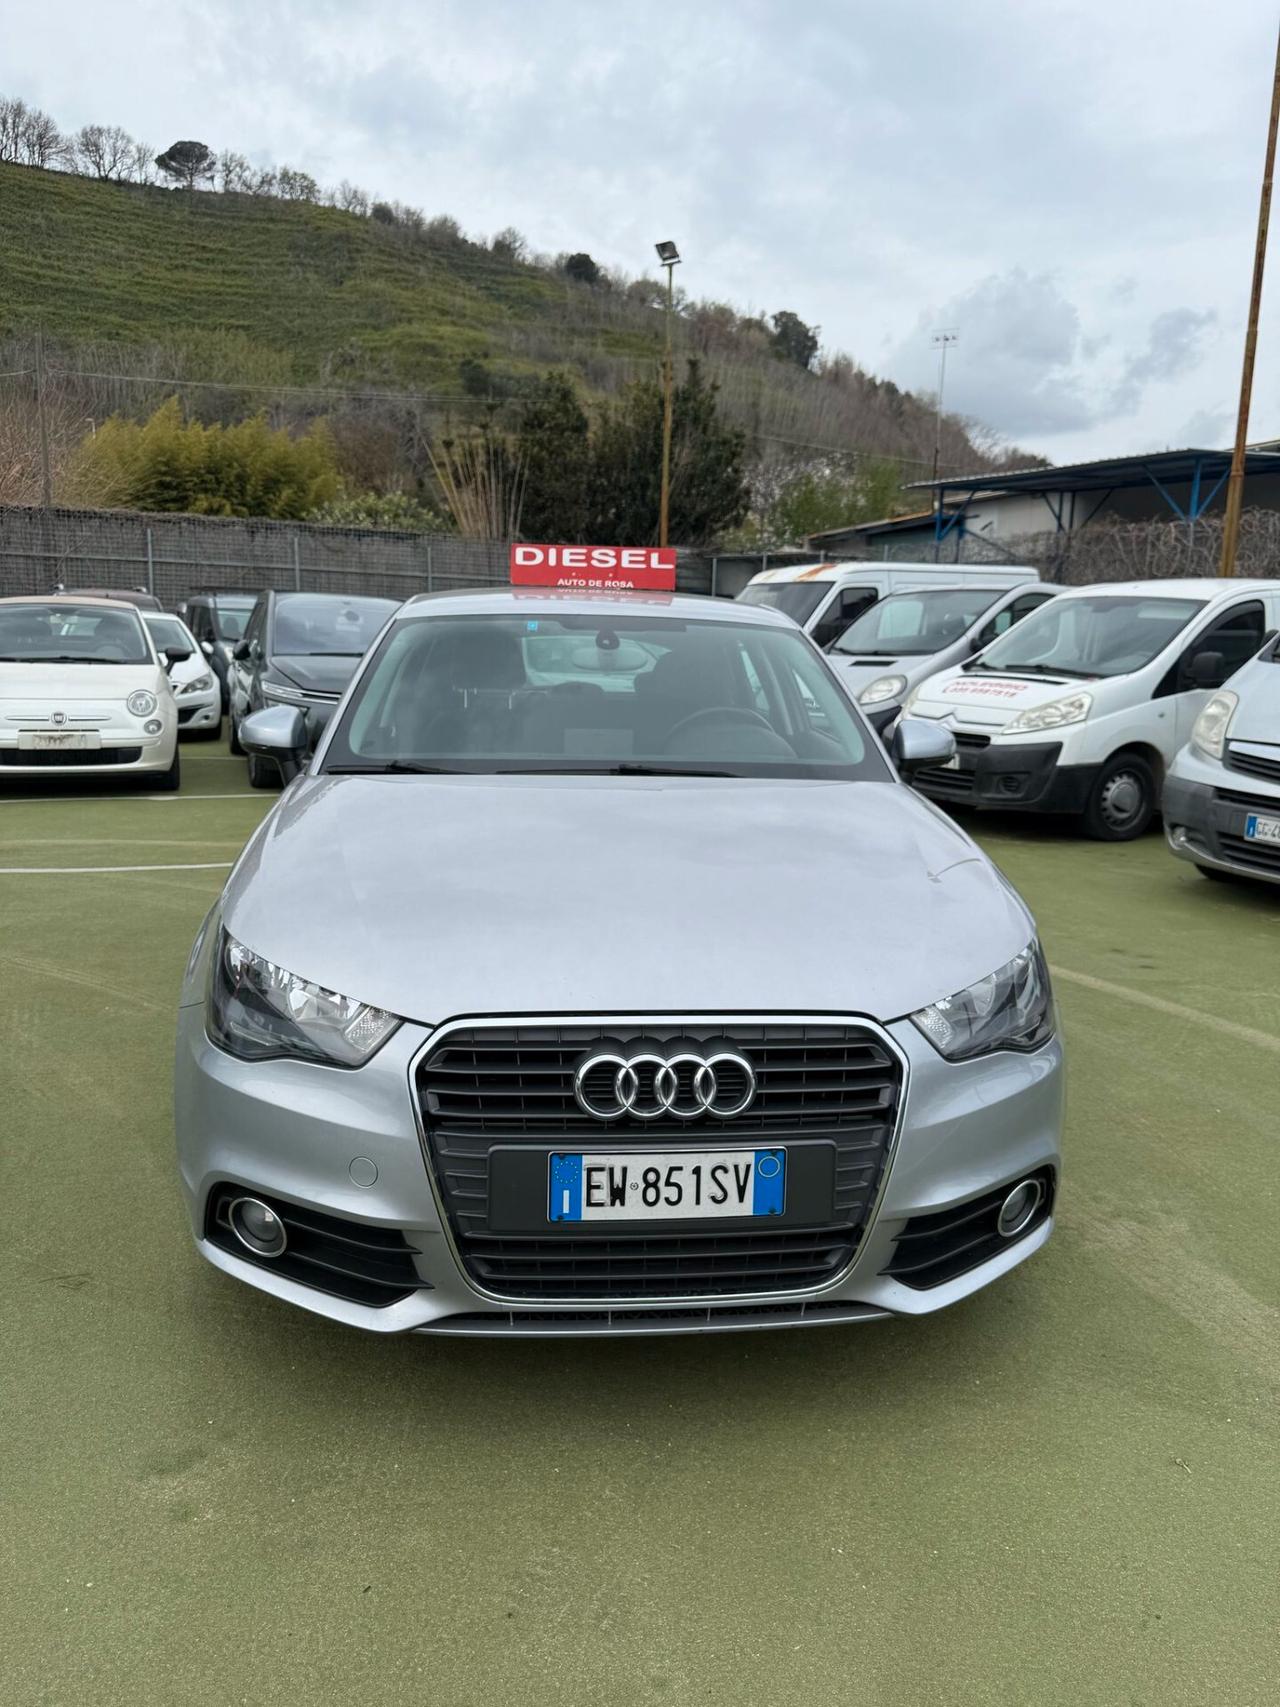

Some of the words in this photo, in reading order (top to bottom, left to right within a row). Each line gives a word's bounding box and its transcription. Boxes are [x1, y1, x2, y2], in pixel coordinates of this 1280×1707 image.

[515, 547, 674, 569] DIESEL
[557, 578, 586, 587] AUTO
[588, 579, 602, 587] DE
[604, 580, 634, 589] ROSA
